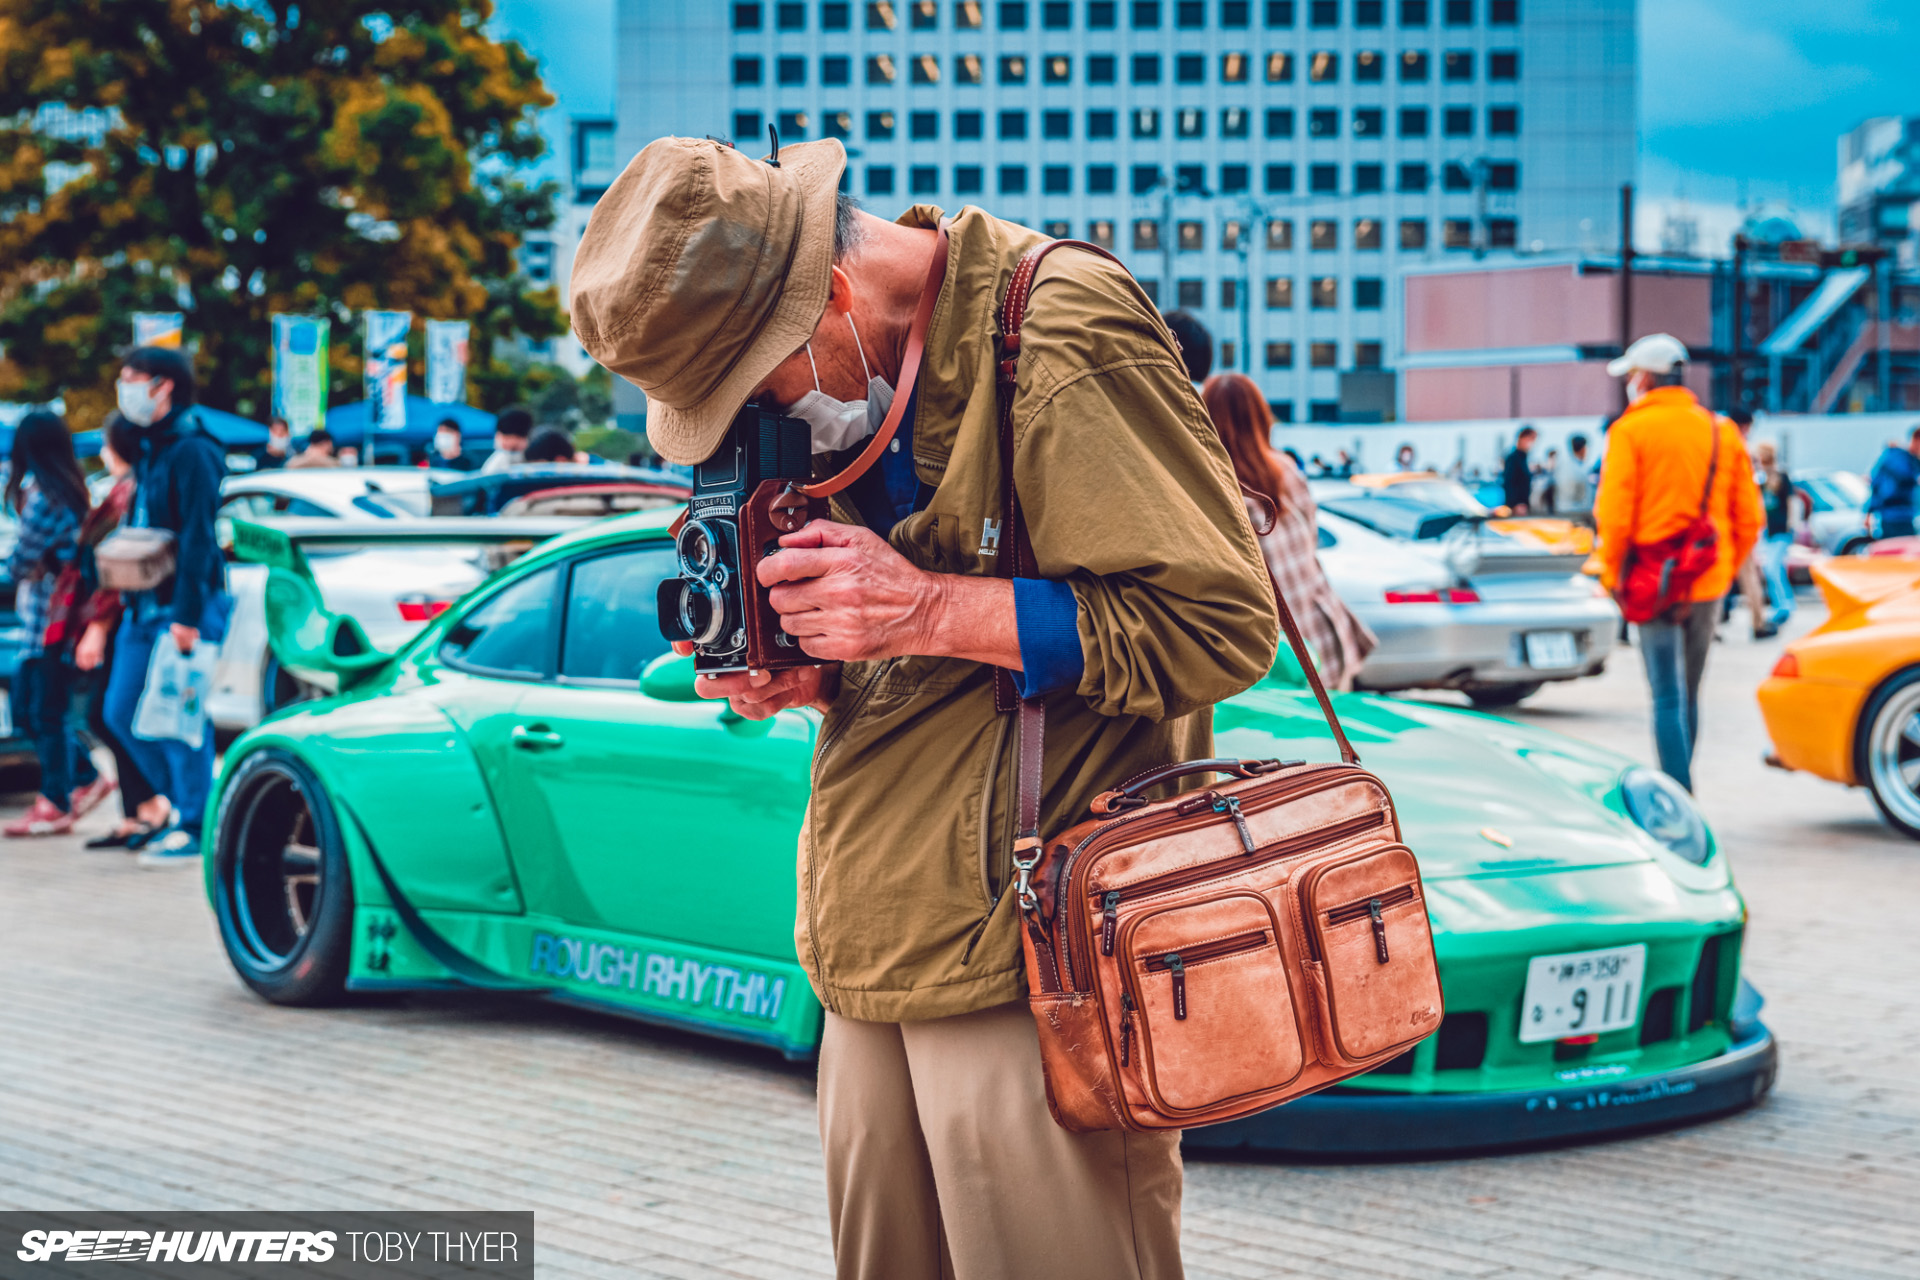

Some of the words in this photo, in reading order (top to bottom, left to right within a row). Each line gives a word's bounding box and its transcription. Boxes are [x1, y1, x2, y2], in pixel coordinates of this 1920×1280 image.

[694, 497, 733, 509] ROLLEIFLEX
[530, 933, 640, 991] ROUGH
[643, 952, 787, 1021] RHYTHM
